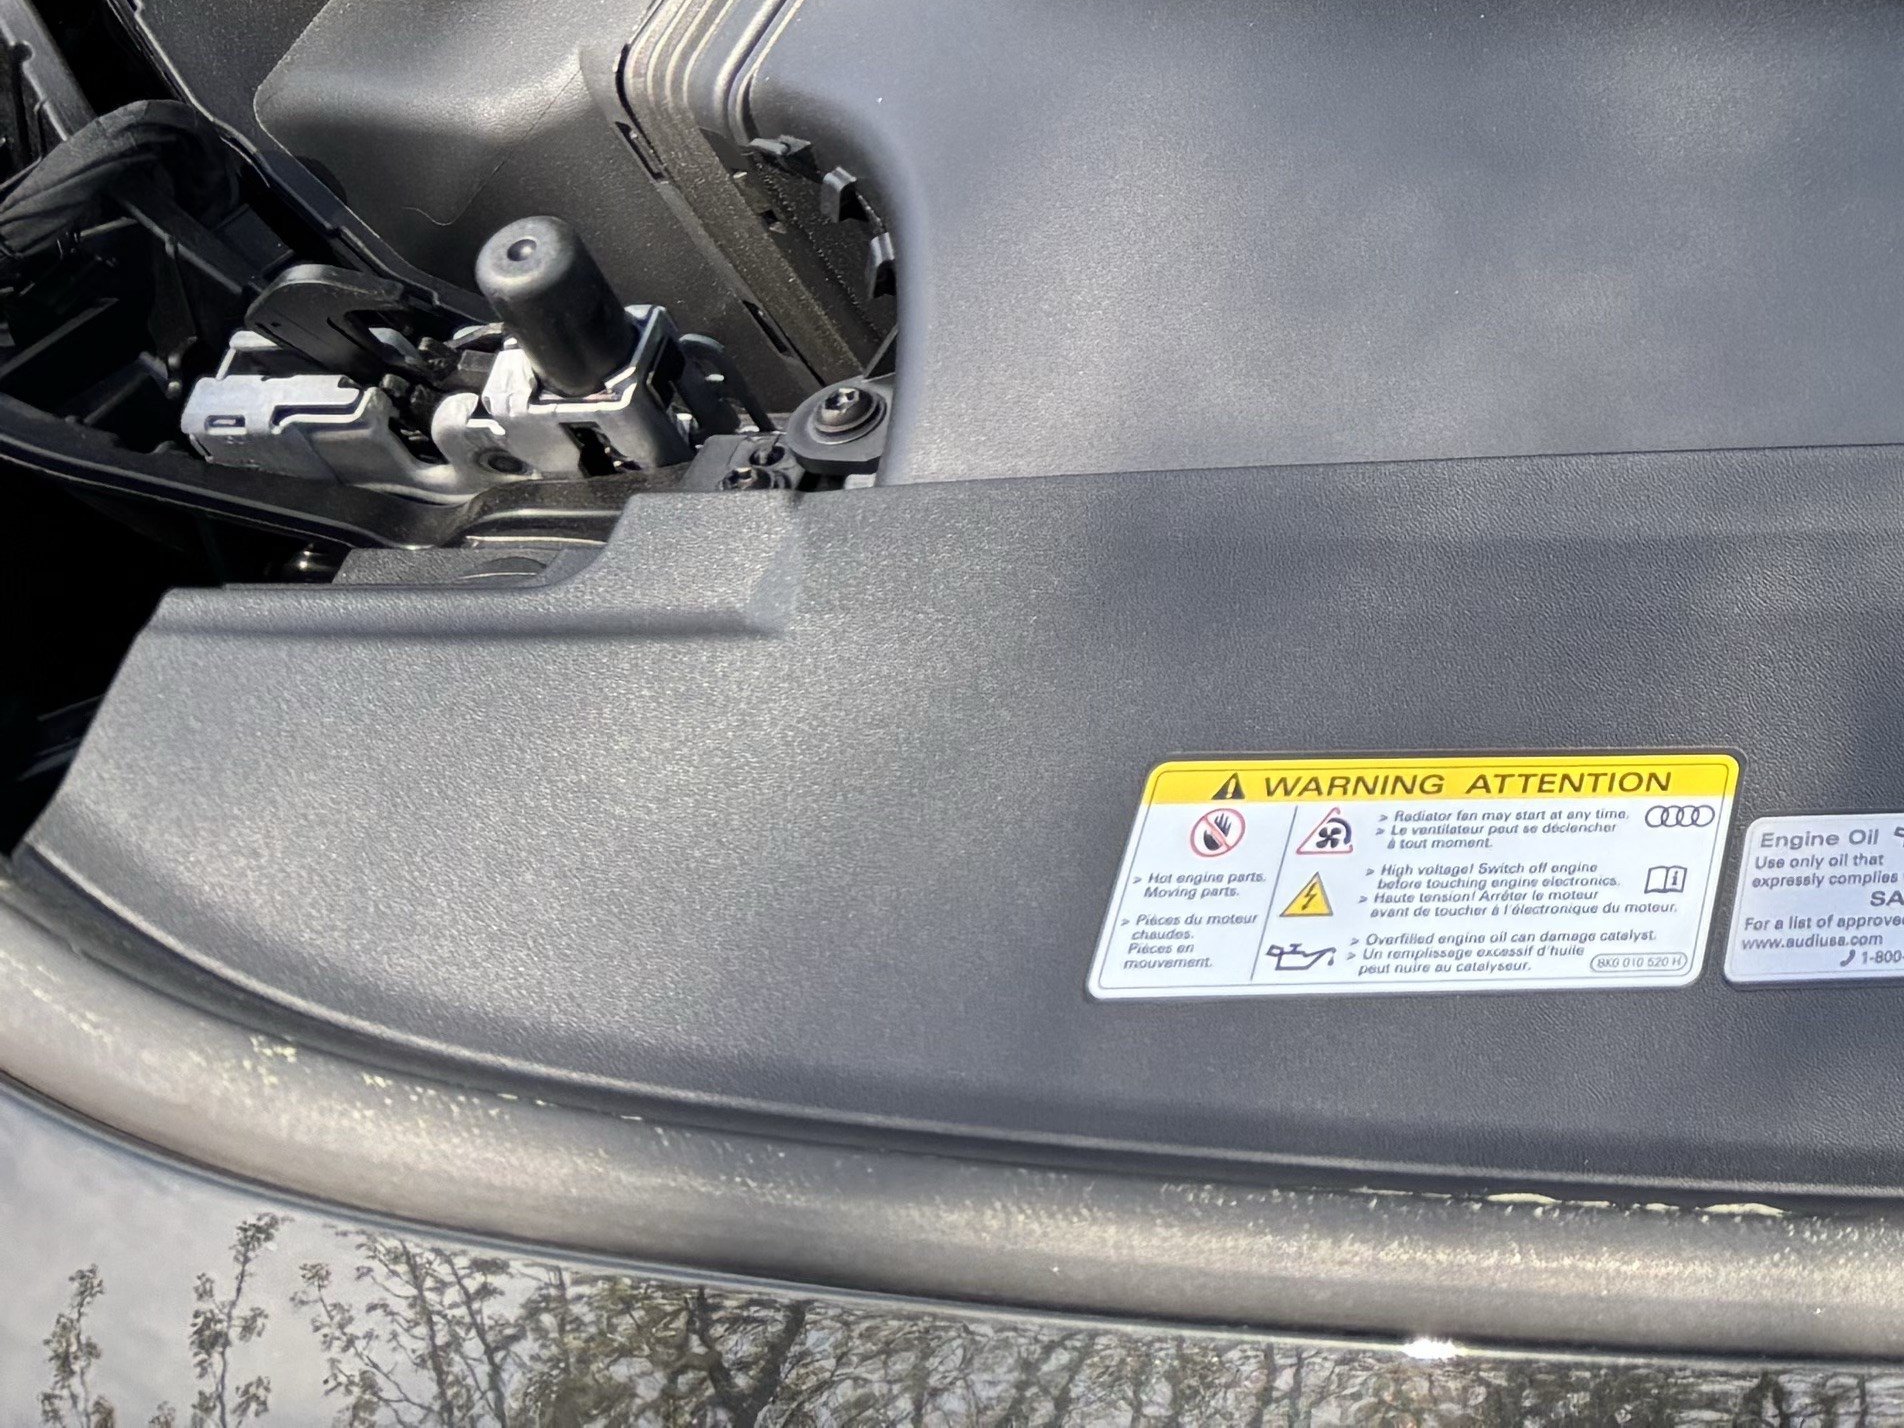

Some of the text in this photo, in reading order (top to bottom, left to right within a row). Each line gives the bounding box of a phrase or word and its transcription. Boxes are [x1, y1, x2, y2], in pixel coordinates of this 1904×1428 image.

[1264, 772, 1671, 797] WARNING ATTENTION
[1394, 810, 1452, 822] Radiator
[1481, 811, 1512, 823] may
[1515, 809, 1546, 821] start
[1566, 809, 1591, 822] any
[1760, 829, 1879, 850] Engine Oil
[1755, 853, 1884, 870] Use only oil that
[1381, 864, 1413, 878] High
[1478, 863, 1524, 875] Switch
[1148, 873, 1172, 884] Hot
[1176, 873, 1224, 888] engine
[1426, 876, 1487, 891] touching
[1752, 874, 1825, 890] expressly
[1829, 872, 1898, 888] complies
[1144, 887, 1197, 900] Moving
[1374, 892, 1414, 903] Haute
[1548, 889, 1599, 900] moteur
[1184, 915, 1202, 925] du
[1206, 914, 1258, 924] moteur
[1370, 906, 1410, 919] avant
[1744, 917, 1770, 931] For
[1774, 920, 1784, 930] a
[1789, 916, 1812, 929] list
[1816, 914, 1833, 928] of
[1366, 933, 1435, 946] Overfilled
[1490, 931, 1507, 943] oil
[1540, 930, 1596, 944] damage
[1741, 934, 1884, 950] www.audiusa.com
